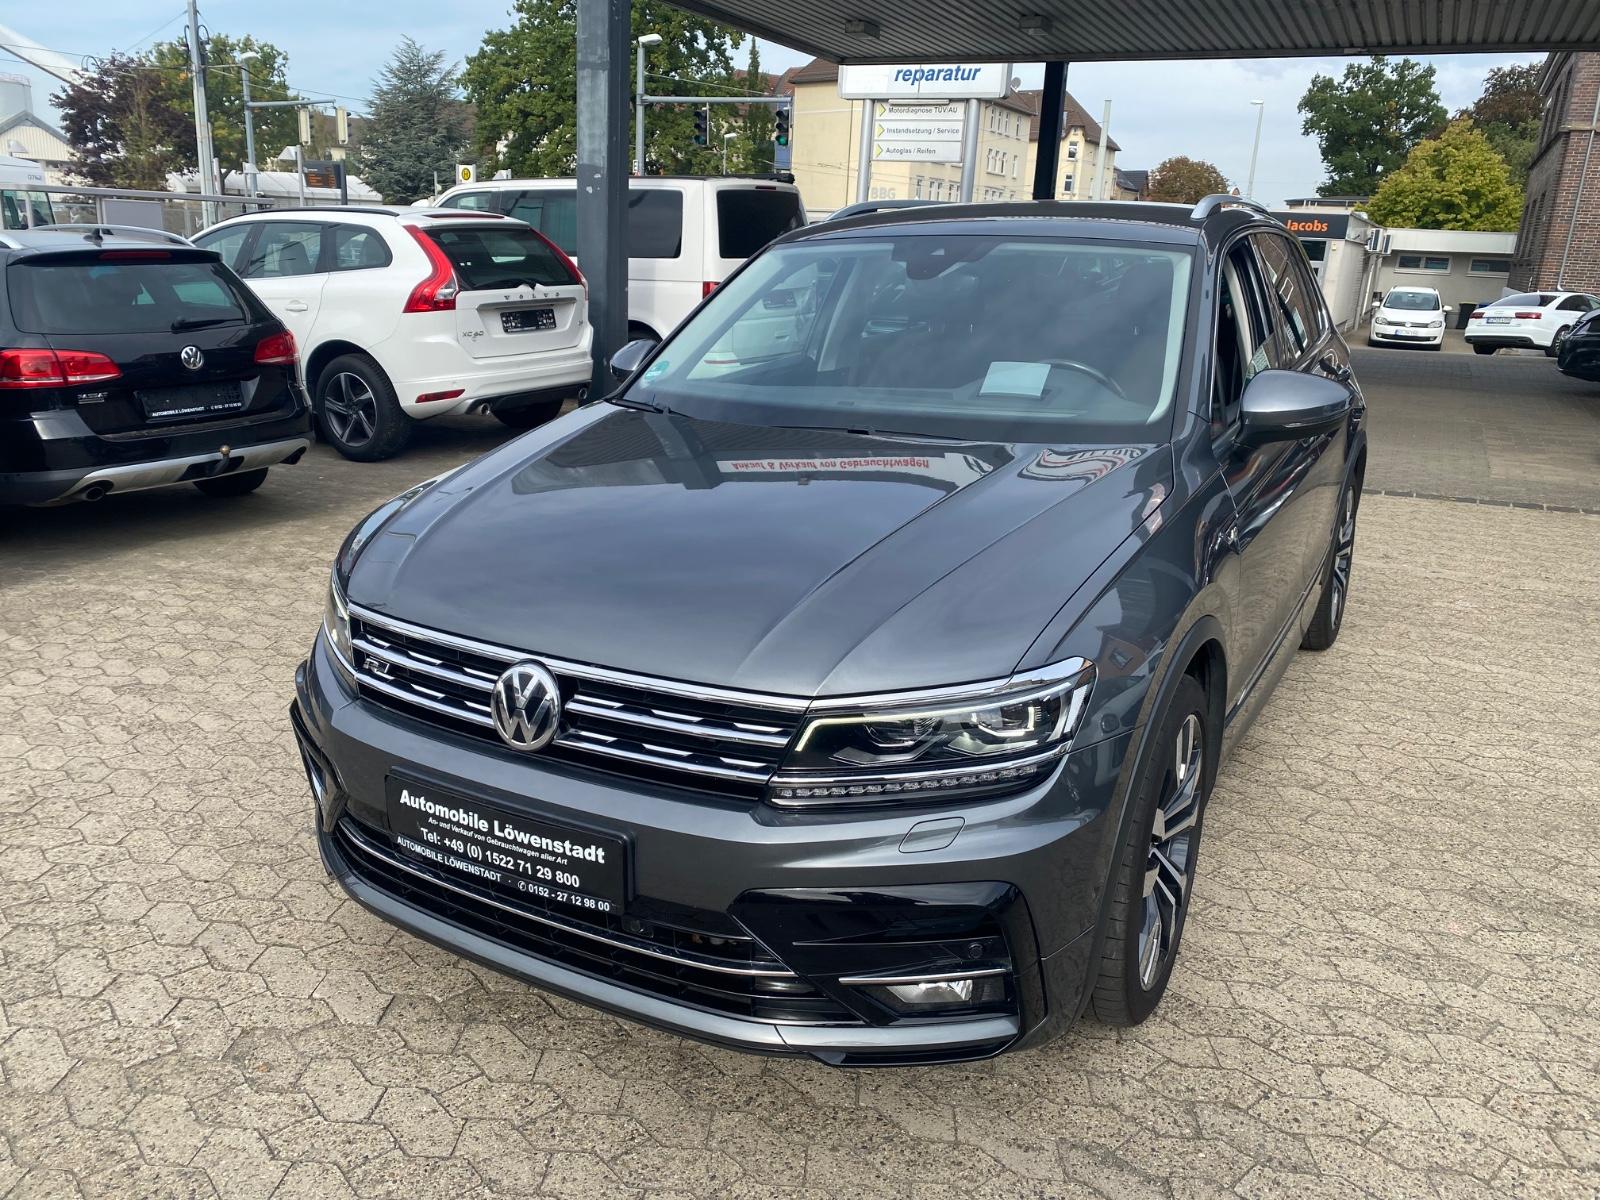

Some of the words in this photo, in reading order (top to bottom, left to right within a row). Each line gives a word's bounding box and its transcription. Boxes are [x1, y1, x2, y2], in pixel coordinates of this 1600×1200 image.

[894, 65, 981, 86] reparatur
[888, 106, 932, 114] Motordiagnose
[886, 127, 932, 135] Instandsetzung
[886, 147, 912, 155] Autoglas
[870, 187, 896, 199] BBG
[504, 291, 561, 300] VOLVO
[400, 789, 489, 832] Automobile
[493, 820, 605, 864] Löwenstadt
[428, 816, 439, 825] An-
[439, 822, 451, 830] und
[451, 824, 474, 838] Verkauf
[473, 833, 486, 842] von
[486, 836, 540, 858] Gebrauchtwagen
[540, 852, 556, 862] aller
[556, 856, 568, 866] Art
[420, 827, 442, 846] Tel:
[443, 837, 465, 854] +49
[466, 842, 483, 861] (0)
[485, 850, 515, 870] 1522
[517, 859, 532, 876] 71
[536, 865, 553, 881] 29
[555, 870, 580, 888] 800
[397, 836, 444, 863] AUTOMOBILE
[444, 855, 502, 883] LÖWENSTADT
[528, 883, 550, 898] 0152
[556, 891, 568, 902] 27
[570, 895, 582, 906] 12
[583, 898, 596, 909] 98
[597, 901, 611, 912] 00
